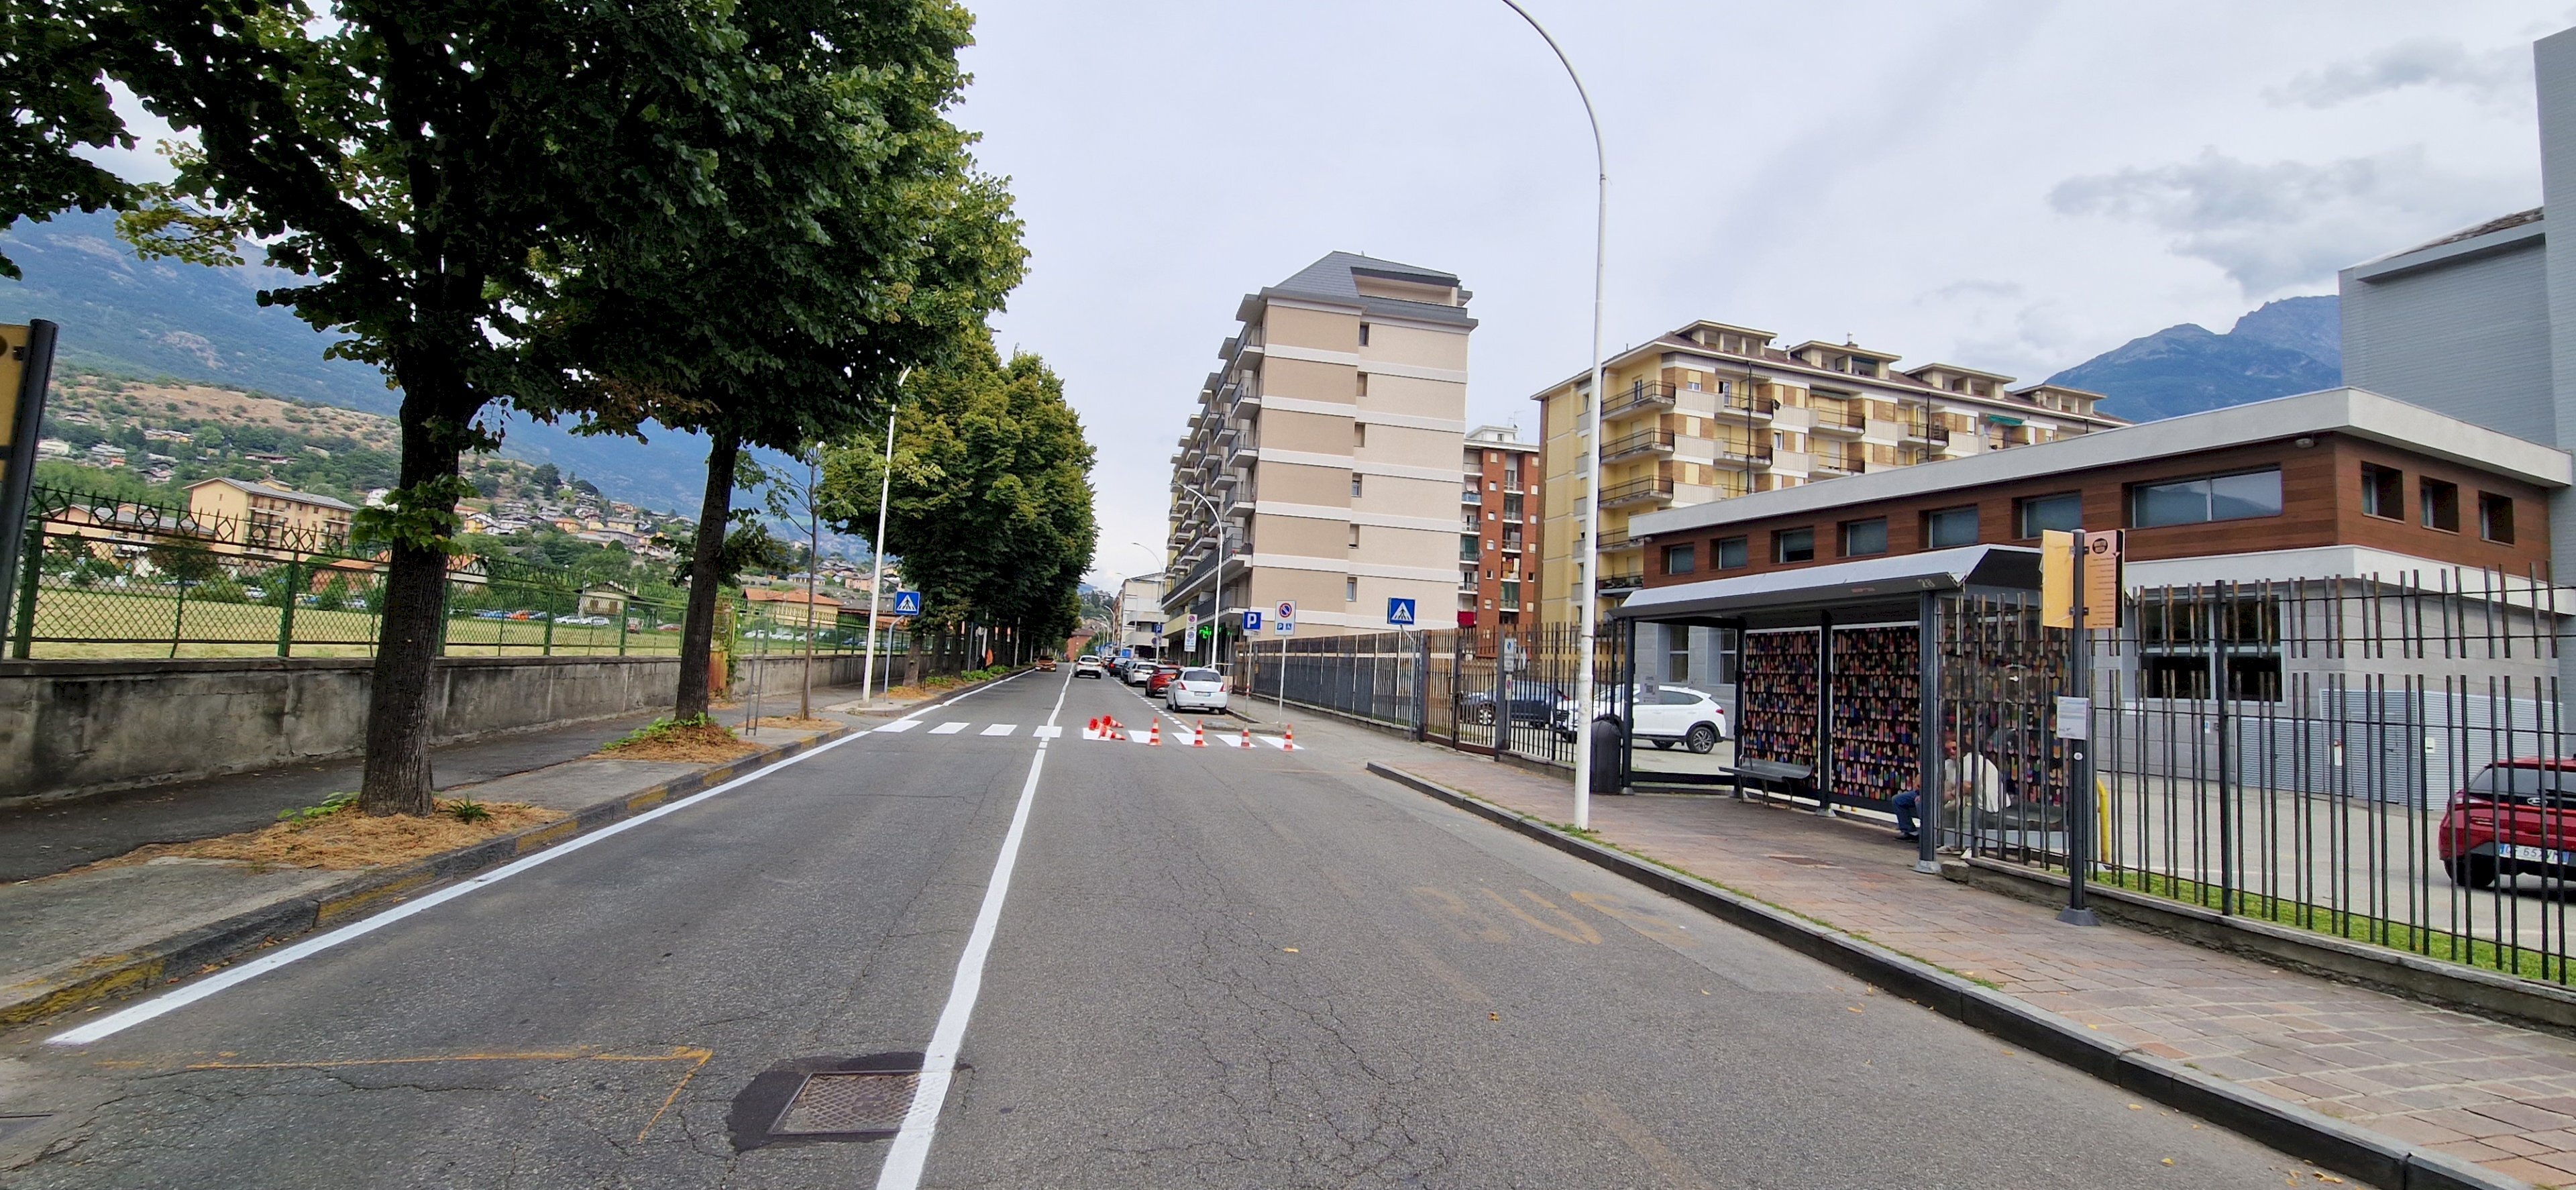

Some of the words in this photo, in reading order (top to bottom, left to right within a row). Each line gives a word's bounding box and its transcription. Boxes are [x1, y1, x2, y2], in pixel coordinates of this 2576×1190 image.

[1917, 578, 1935, 588] 28
[1247, 613, 1257, 629] P
[1411, 885, 1703, 947] BUS
